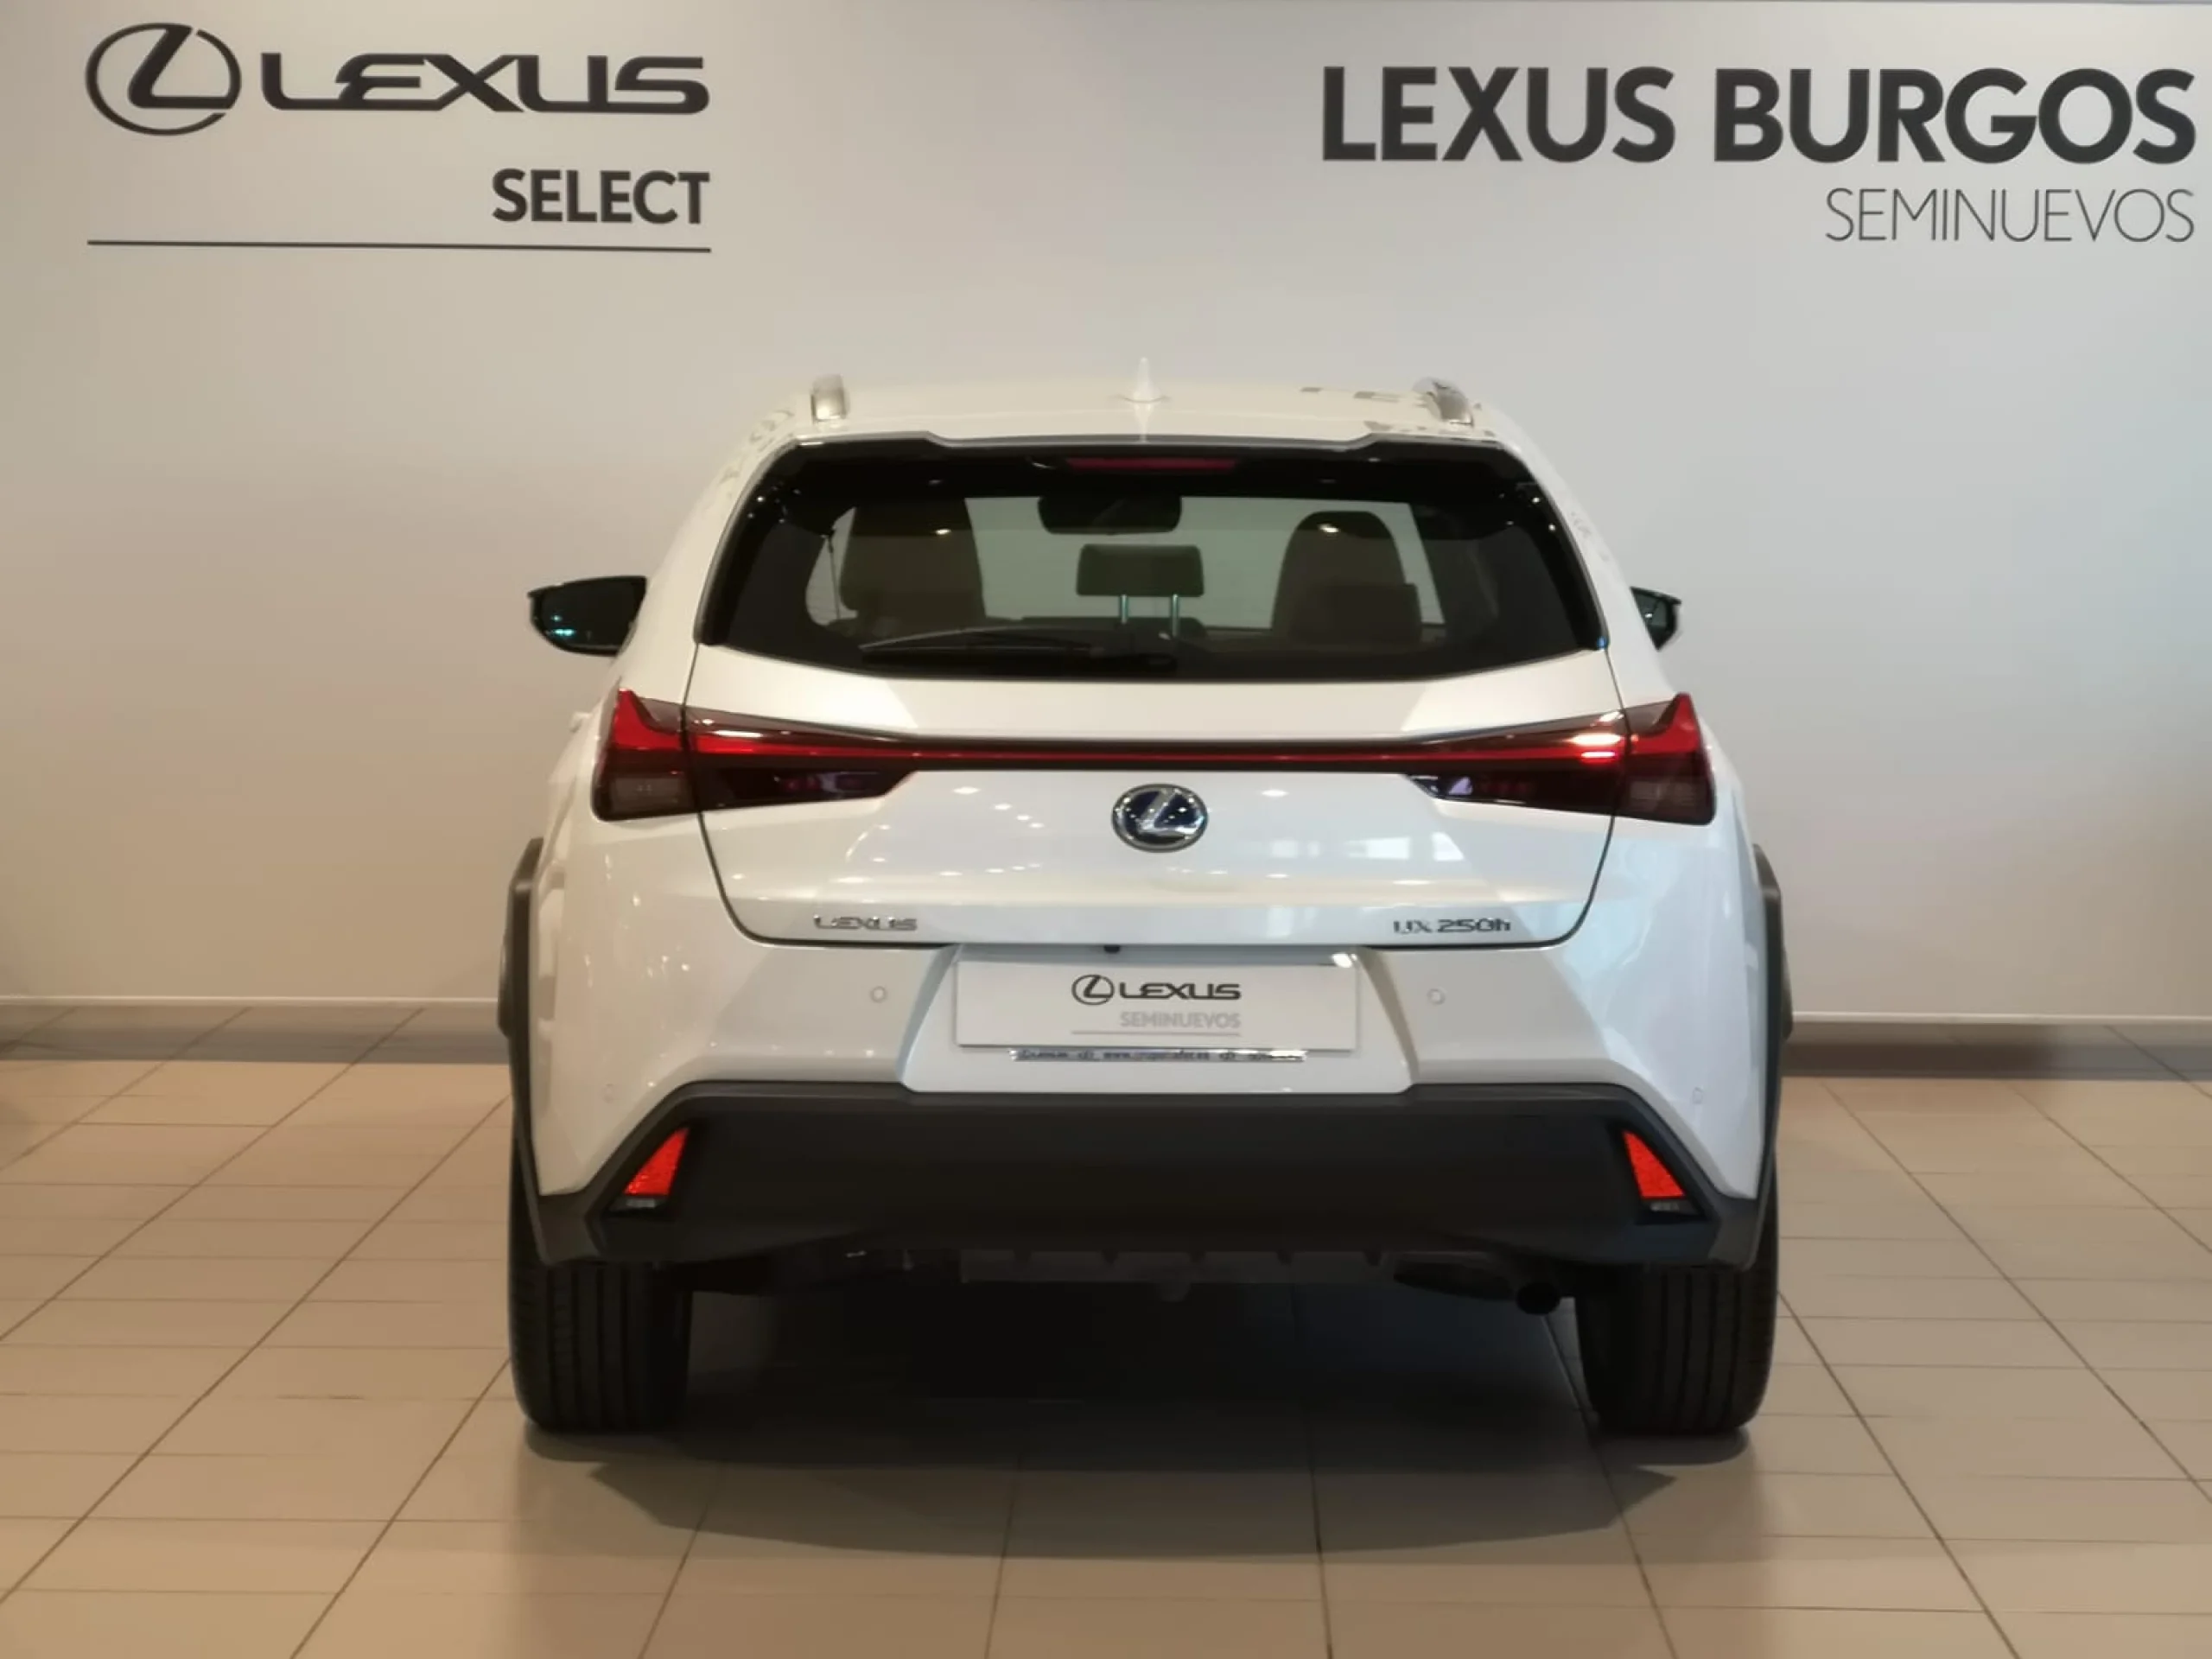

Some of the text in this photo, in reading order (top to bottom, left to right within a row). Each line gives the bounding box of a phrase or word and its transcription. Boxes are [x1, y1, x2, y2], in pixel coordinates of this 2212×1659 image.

[261, 52, 711, 115] LEXUS
[1322, 66, 2196, 164] LEXUS BURGOS
[492, 168, 711, 225] SELECT
[1825, 188, 2196, 243] SEMINUEVOS
[813, 914, 918, 931] LEXUS
[1393, 917, 1512, 934] UX 250h
[1118, 982, 1243, 1001] LEXUS
[1120, 1011, 1243, 1029] SEMINUEVOS
